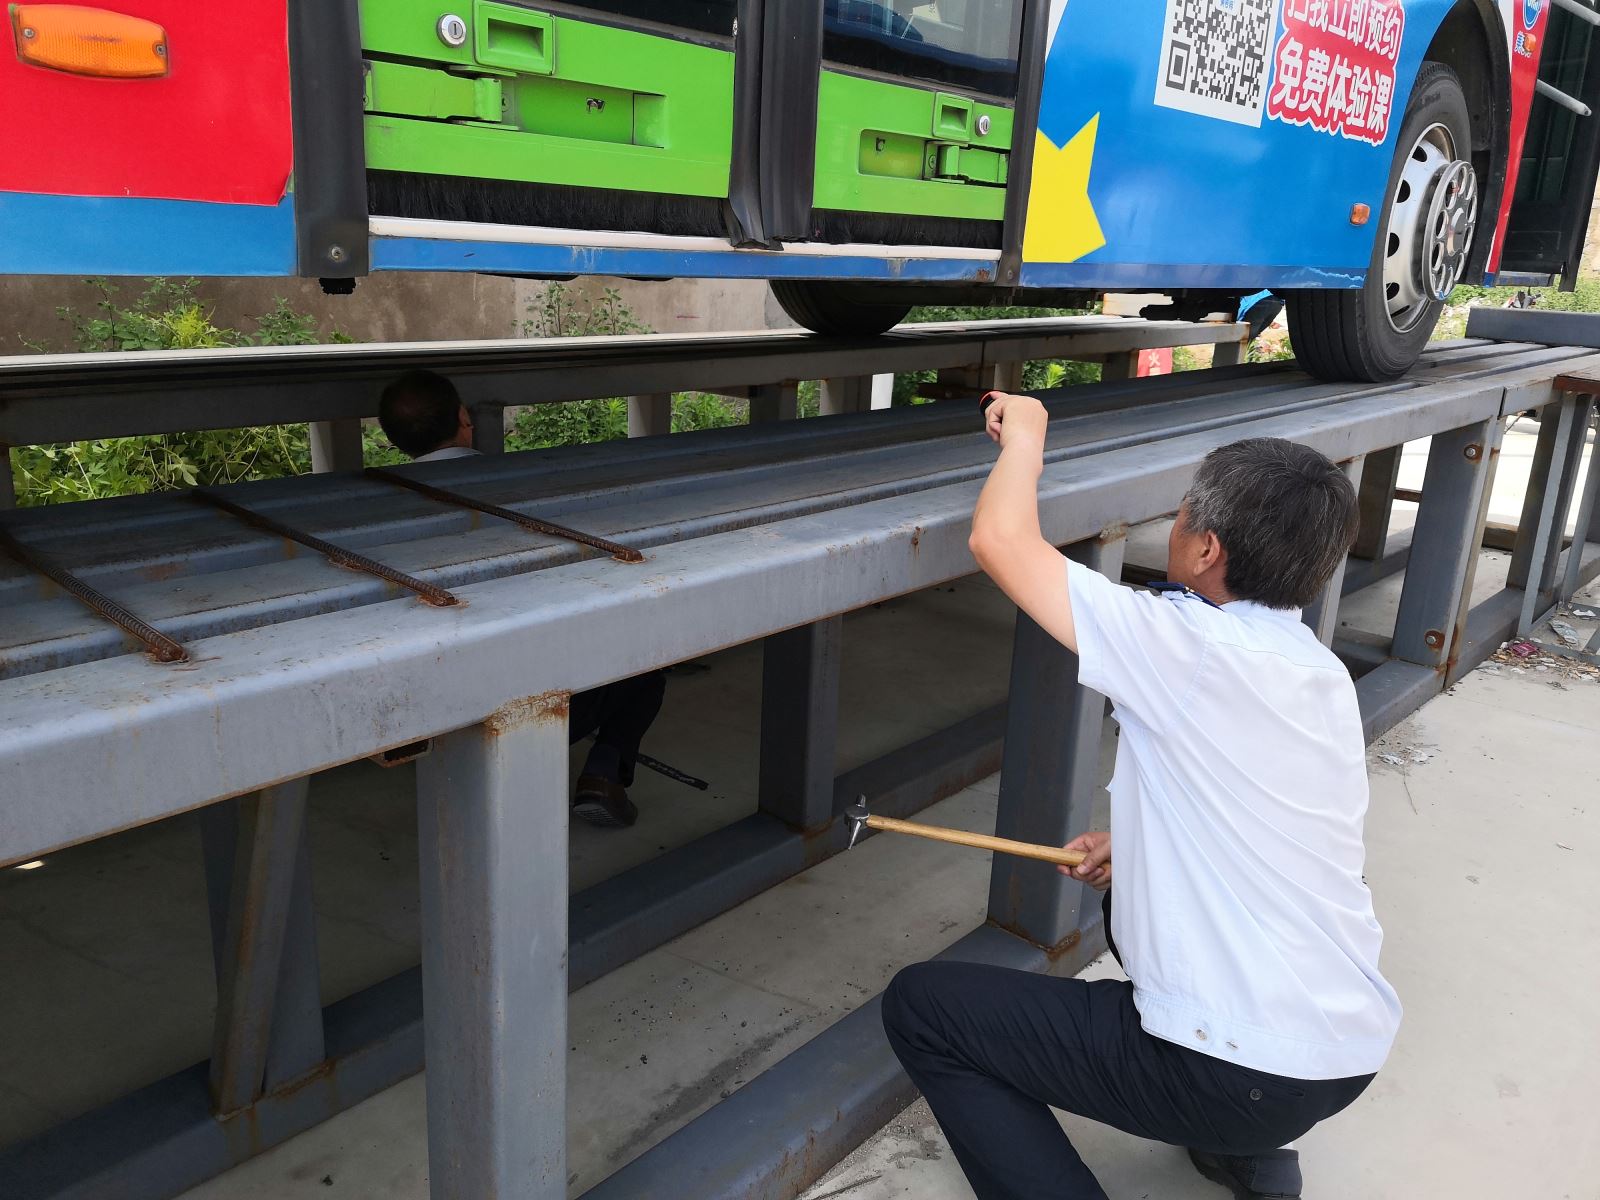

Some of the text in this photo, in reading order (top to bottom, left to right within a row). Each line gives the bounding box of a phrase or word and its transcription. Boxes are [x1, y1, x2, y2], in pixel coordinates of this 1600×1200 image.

[1273, 37, 1392, 133] 免费体验课
